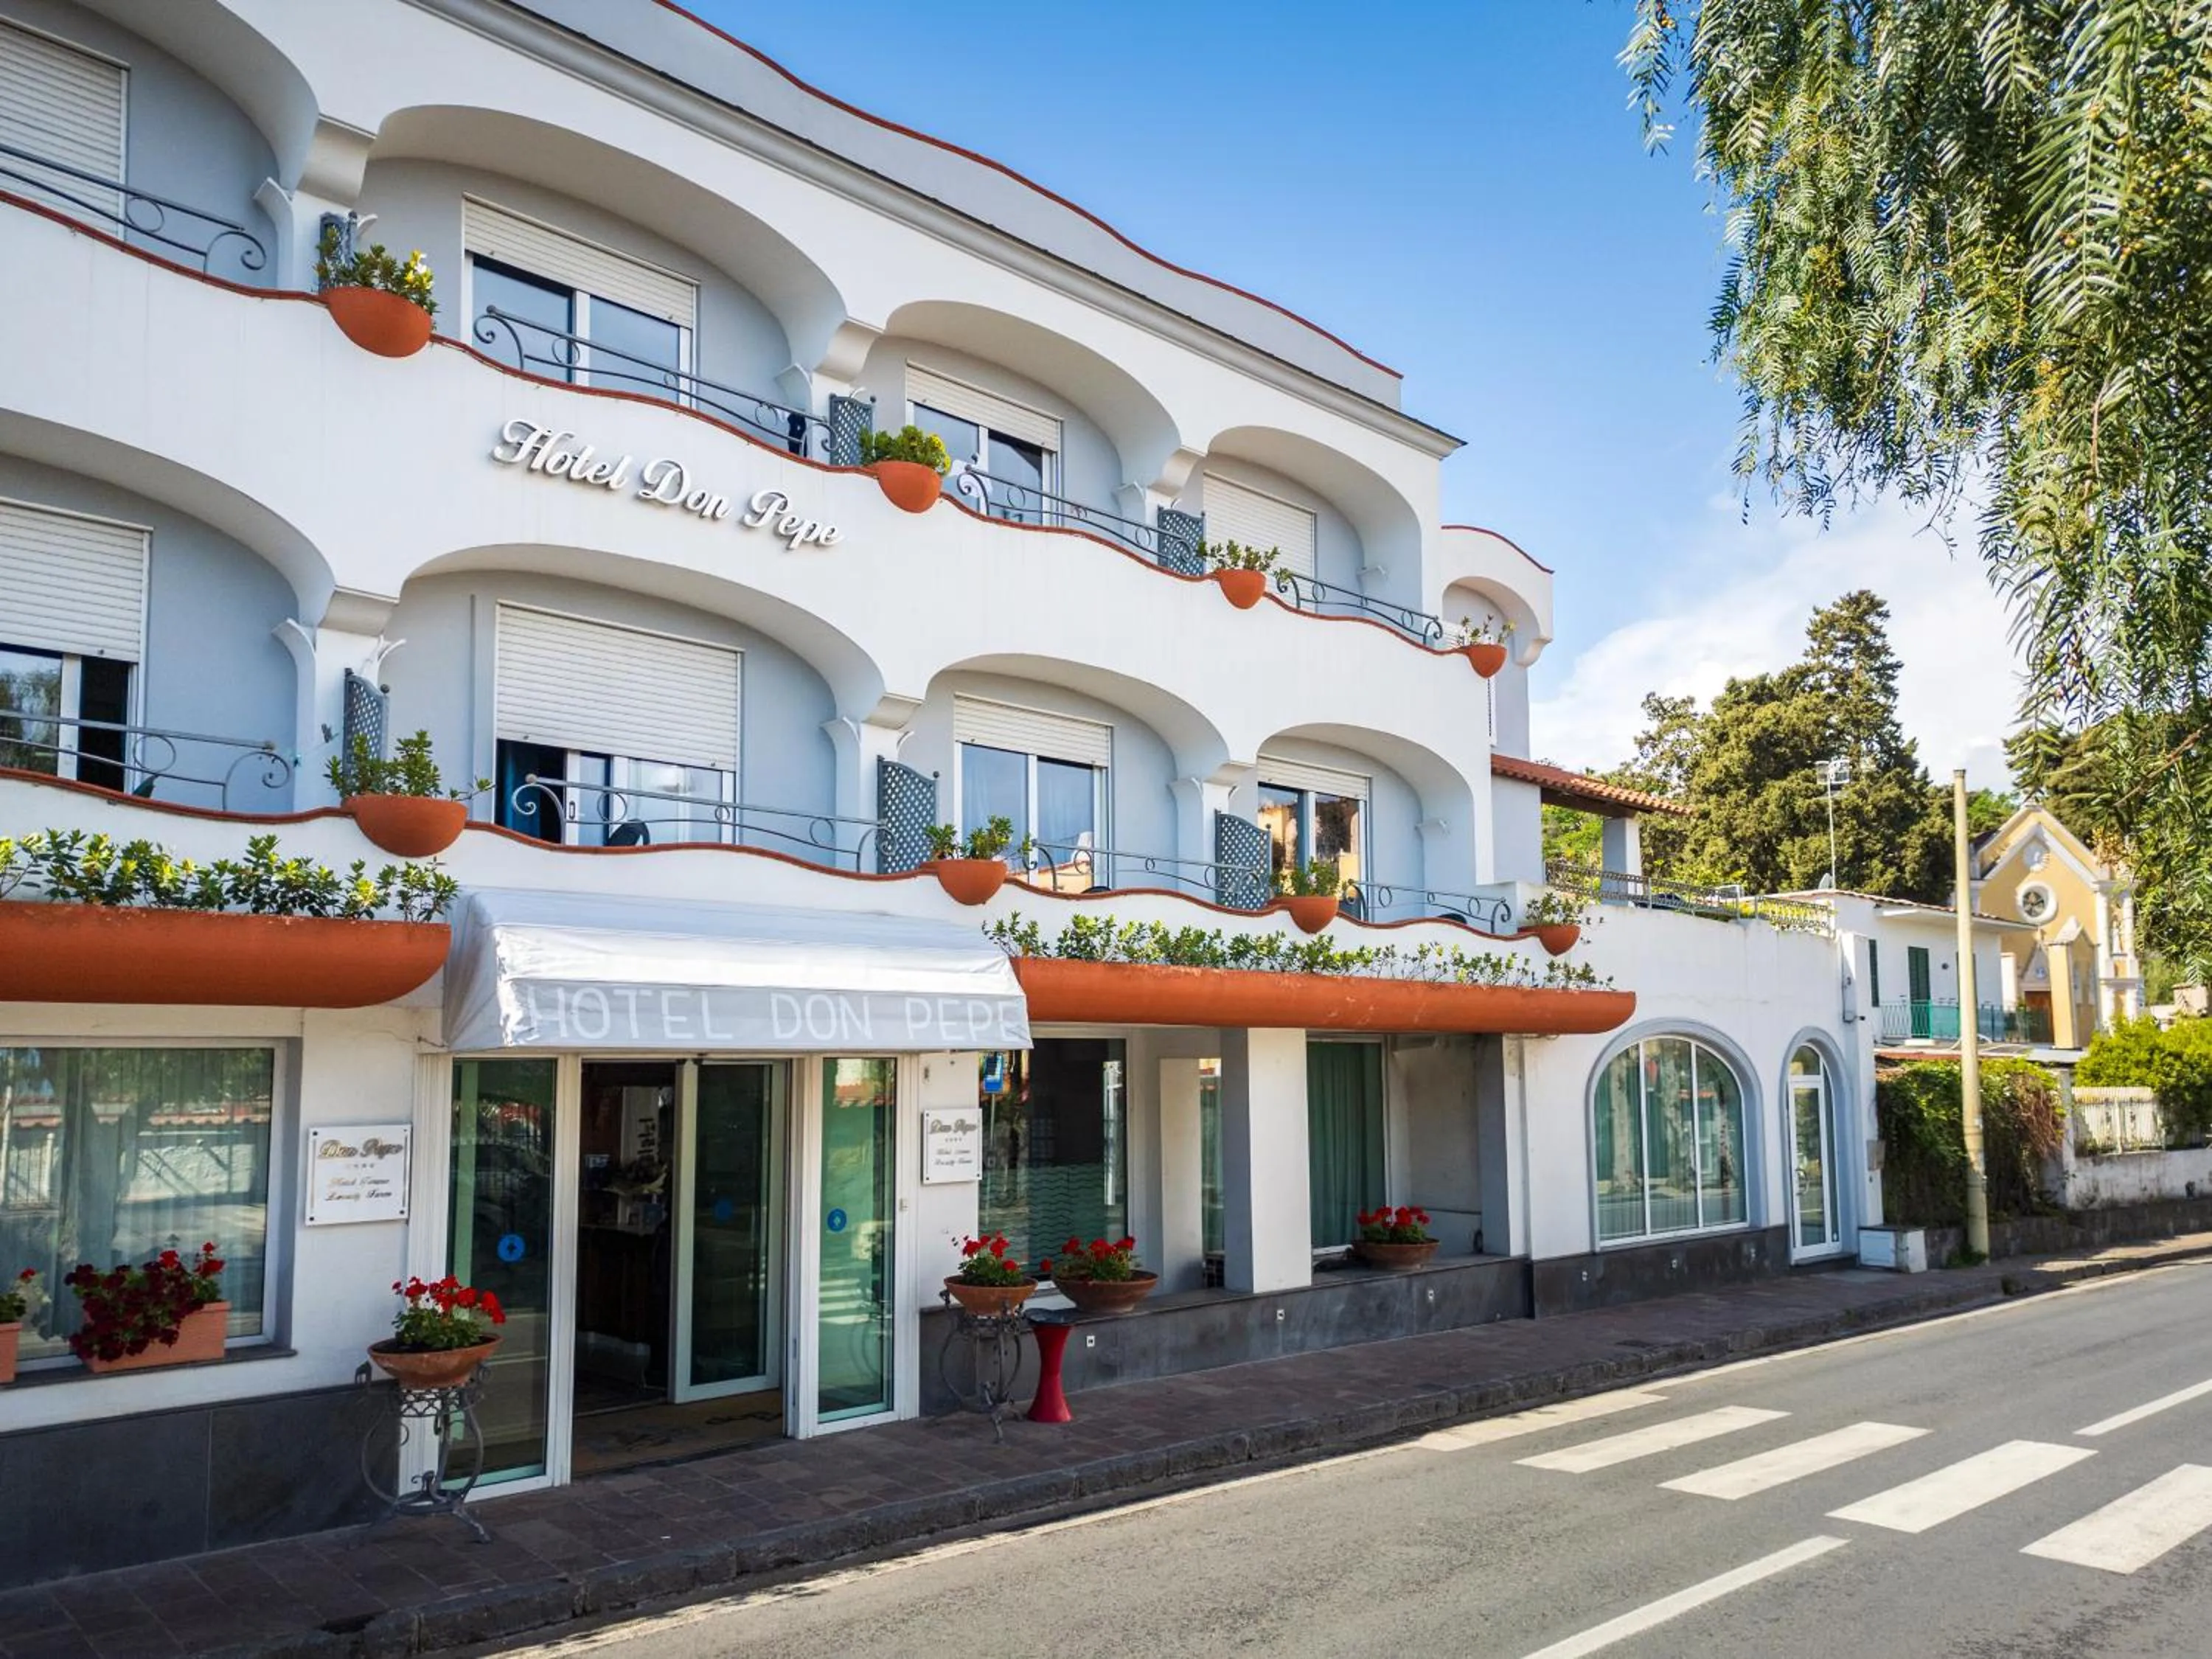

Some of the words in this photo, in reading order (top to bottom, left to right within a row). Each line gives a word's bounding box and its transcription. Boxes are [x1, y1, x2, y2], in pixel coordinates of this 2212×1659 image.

[493, 418, 633, 490] Hotel
[638, 457, 732, 519] Don
[742, 488, 844, 550] Pepe
[527, 986, 733, 1040] HOTEL
[771, 992, 874, 1040] DON
[905, 996, 1020, 1043] PEPE
